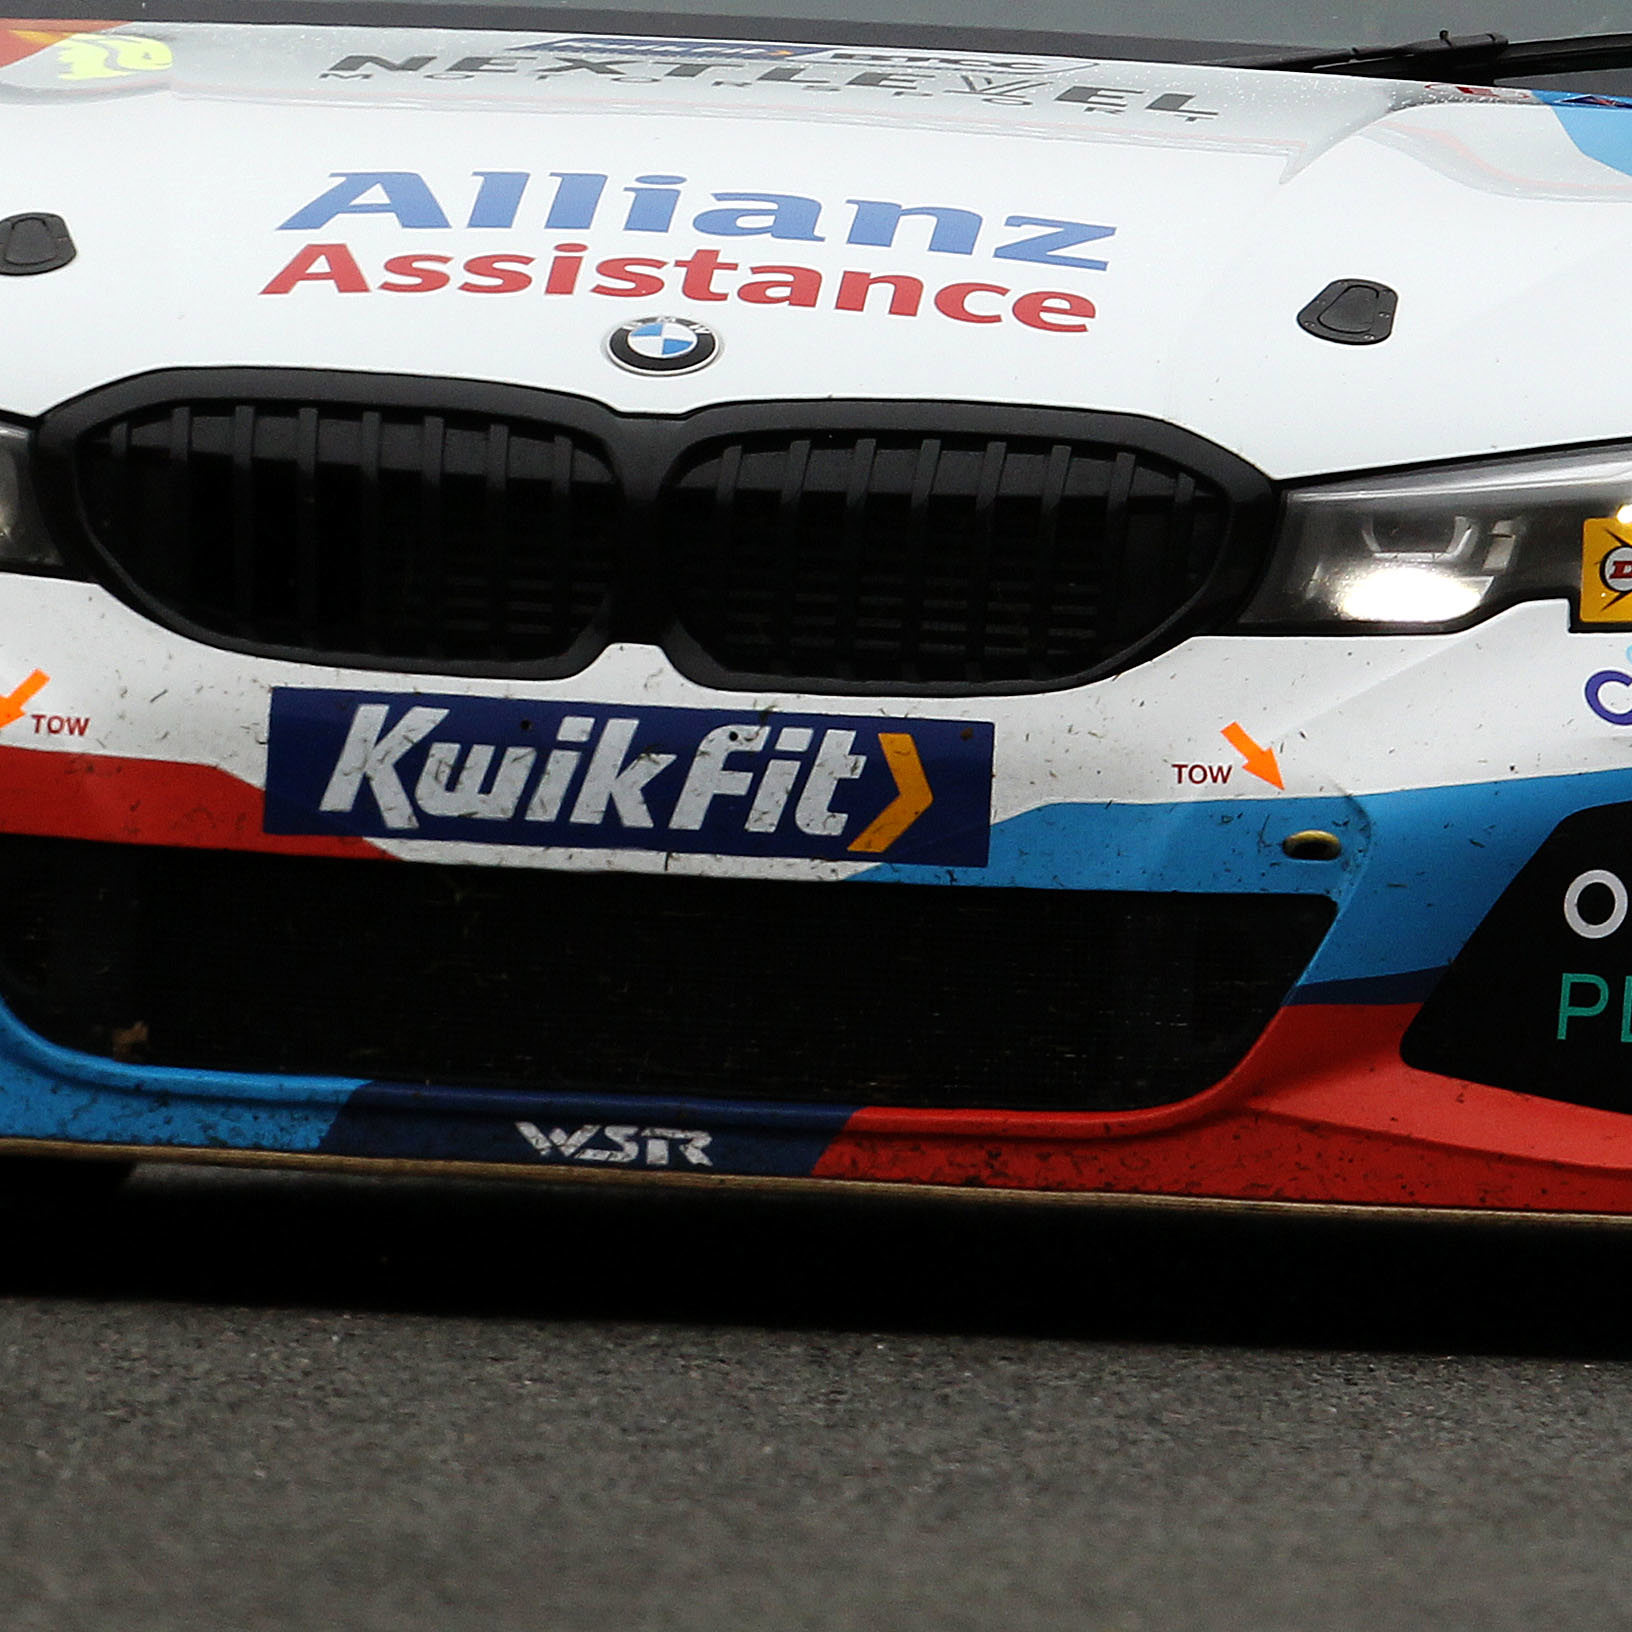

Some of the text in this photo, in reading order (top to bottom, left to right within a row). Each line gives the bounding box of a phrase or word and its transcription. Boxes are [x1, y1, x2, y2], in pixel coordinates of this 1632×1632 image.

[273, 171, 1118, 272] Allianz
[258, 242, 1098, 334] Assistance
[31, 713, 91, 738] TOW
[1172, 763, 1233, 785] TOW
[514, 1121, 714, 1168] WSR
